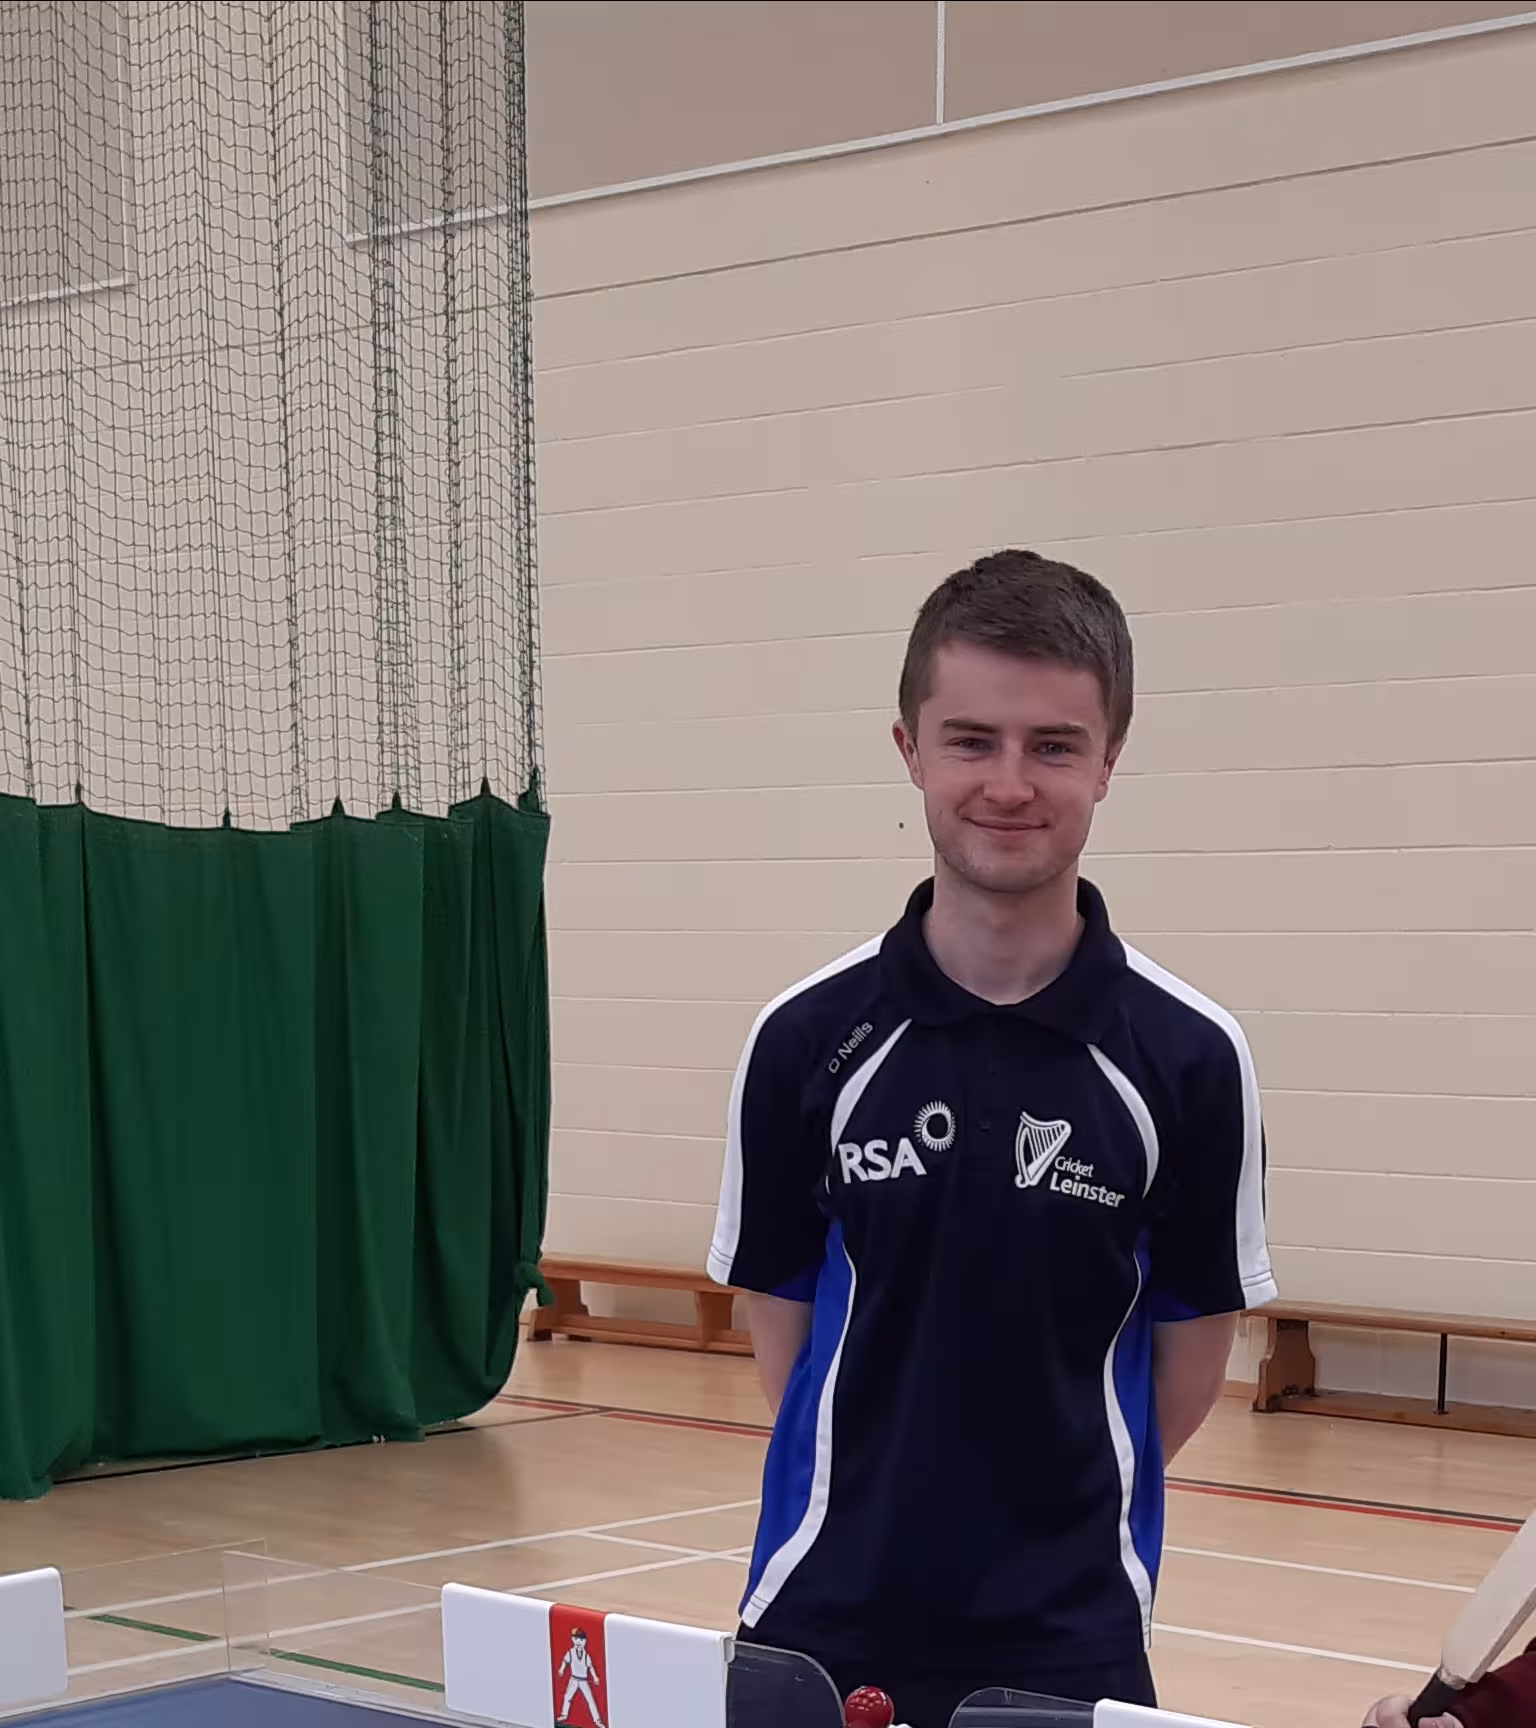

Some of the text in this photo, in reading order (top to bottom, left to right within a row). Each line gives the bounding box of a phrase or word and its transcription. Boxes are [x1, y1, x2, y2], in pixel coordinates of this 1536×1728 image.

[838, 1137, 927, 1184] RSA
[1054, 1156, 1095, 1178] Cricket
[1049, 1171, 1125, 1208] Leinster
